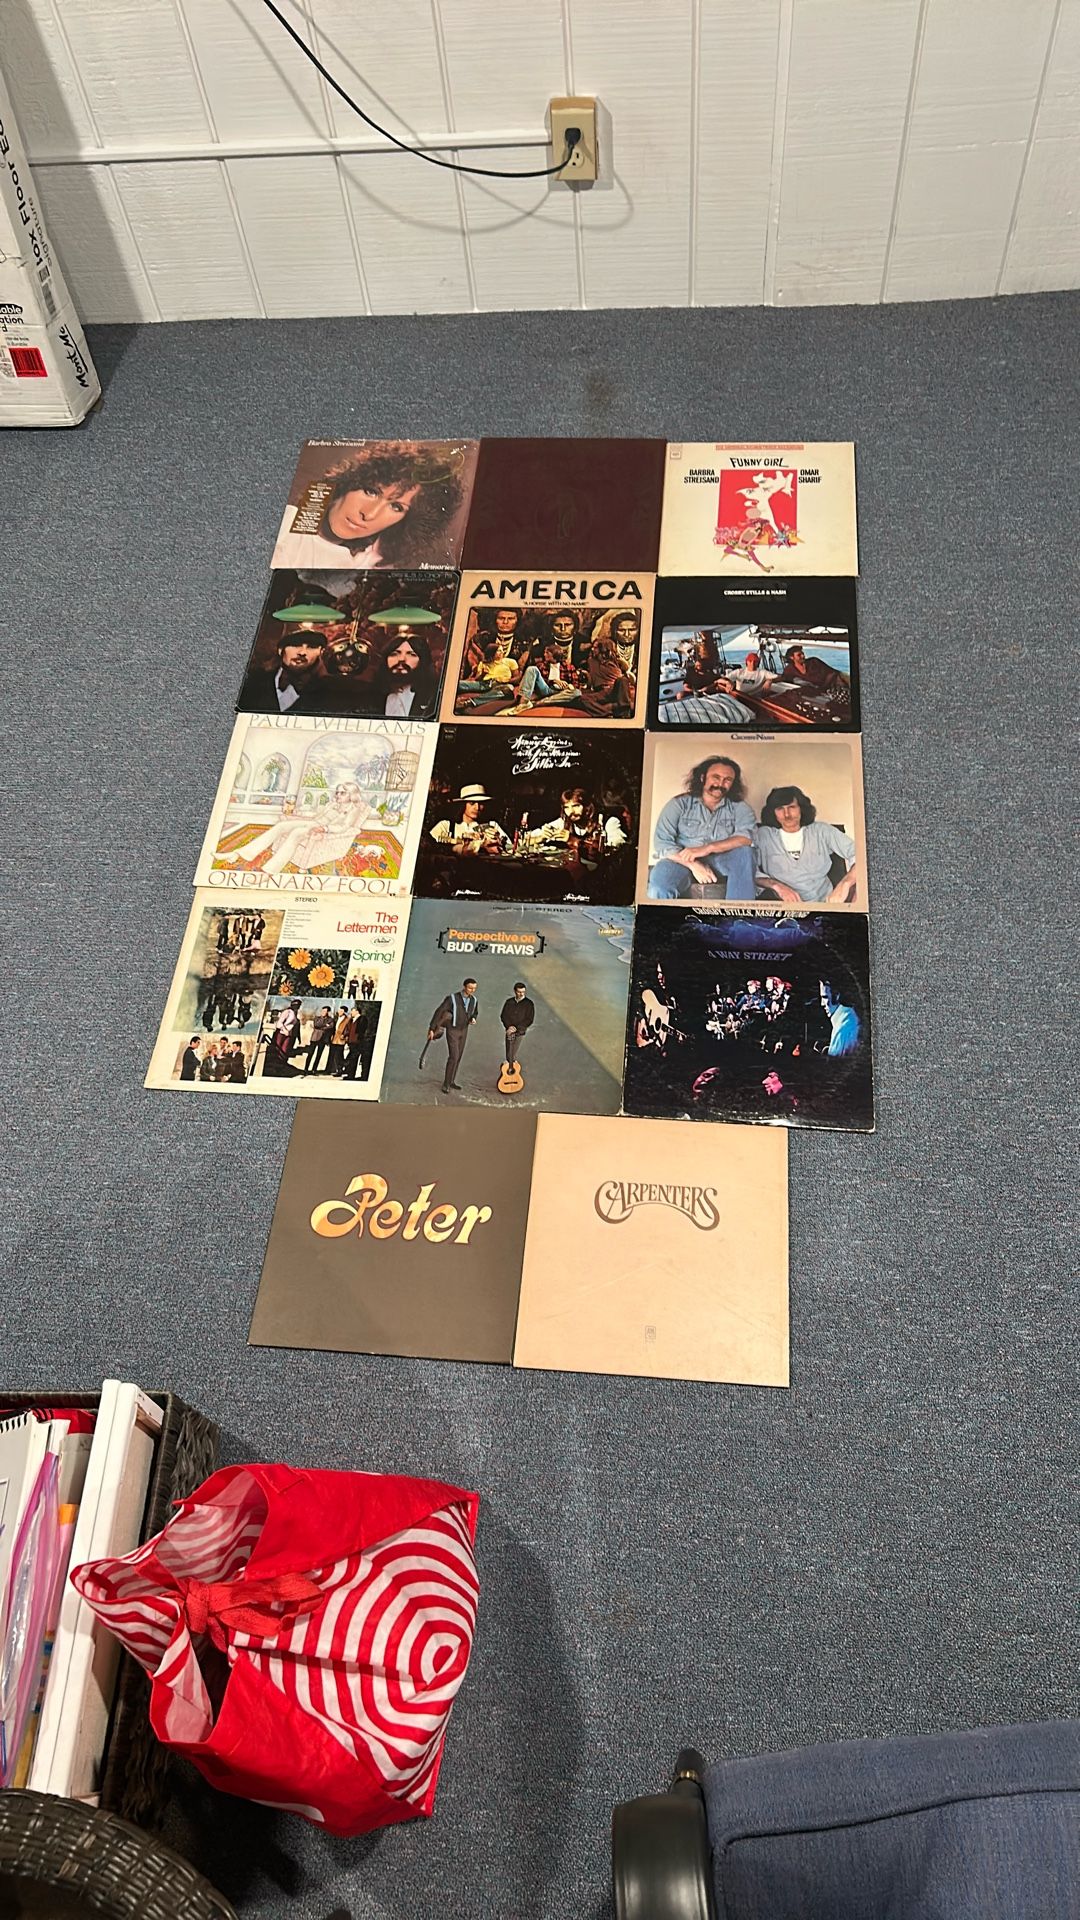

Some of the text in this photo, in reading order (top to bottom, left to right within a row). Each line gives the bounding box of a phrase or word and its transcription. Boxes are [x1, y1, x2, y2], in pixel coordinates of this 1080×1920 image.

[8, 161, 30, 225] Floor
[0, 305, 22, 314] able
[66, 349, 89, 388] Mont
[729, 457, 789, 468] FUNNY GIRL
[683, 476, 720, 484] STREISAND
[798, 476, 822, 484] SHARIF
[418, 562, 455, 571] Memories
[470, 579, 642, 600] AMERICA
[249, 714, 303, 729] PAUL
[313, 716, 427, 734] WILLIAMS
[208, 871, 396, 895] ORDINARY FOOL
[375, 911, 399, 923] The
[754, 909, 775, 918] NASH
[775, 910, 782, 918] &
[336, 921, 398, 934] Lettermen
[448, 929, 536, 943] Perspective on
[447, 941, 535, 956] BUD & TRAVIS
[352, 949, 397, 964] Spring!
[715, 950, 741, 960] WAY
[743, 951, 793, 962] STREET
[310, 1172, 494, 1245] Peter
[594, 1180, 721, 1231] CARPENTERS
